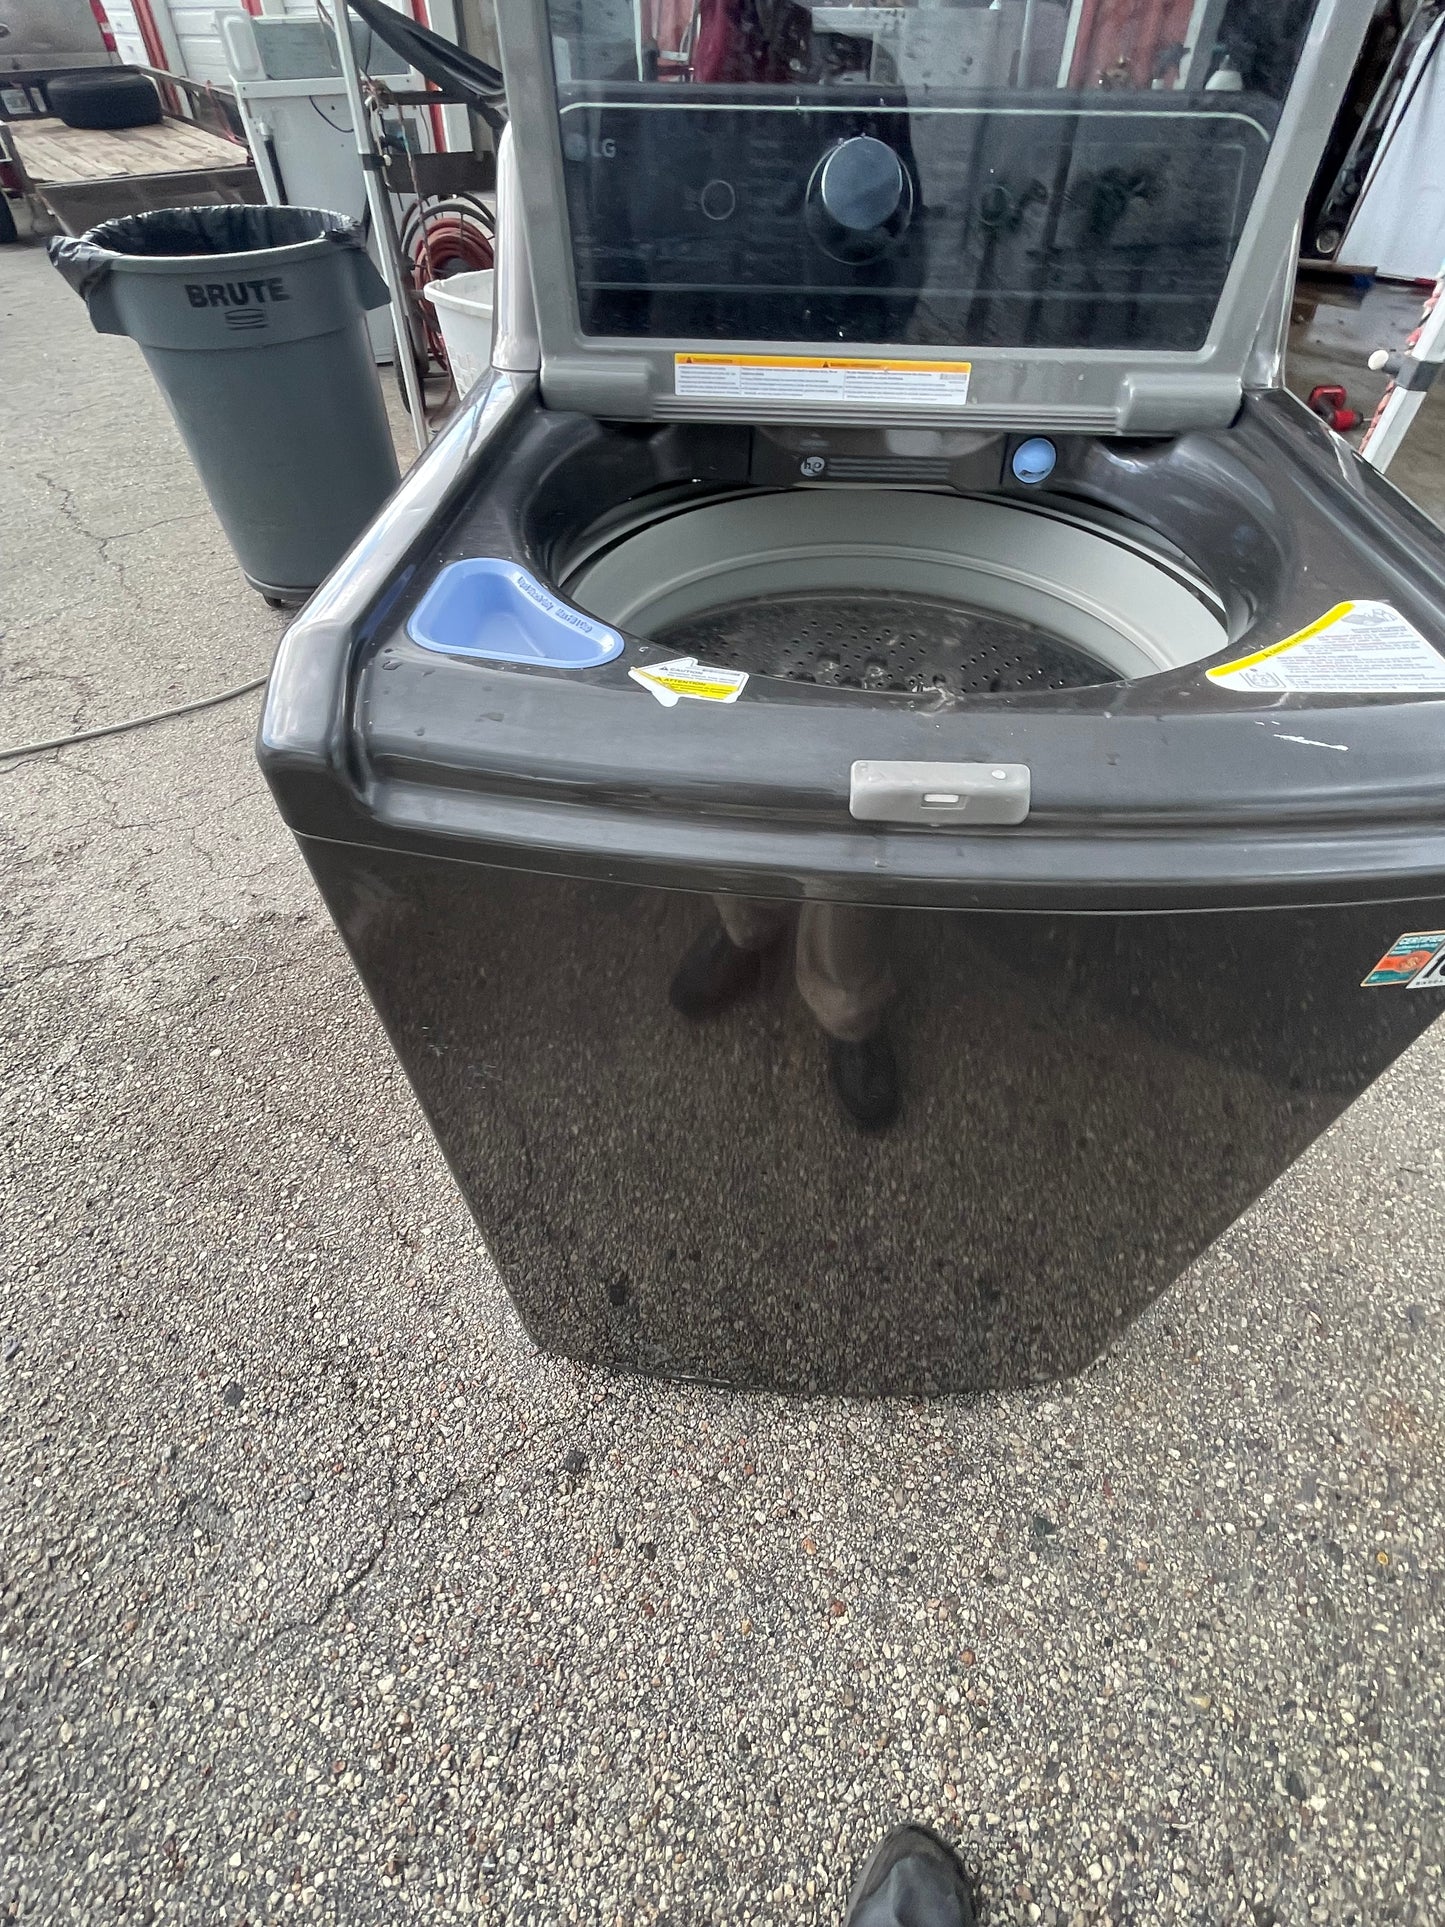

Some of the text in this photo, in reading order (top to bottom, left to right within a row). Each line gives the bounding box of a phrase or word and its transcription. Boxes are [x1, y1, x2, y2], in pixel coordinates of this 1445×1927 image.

[591, 138, 616, 158] LG
[184, 277, 290, 308] BRUTE
[669, 667, 704, 675] CAUTION
[663, 678, 707, 686] ATTENTION
